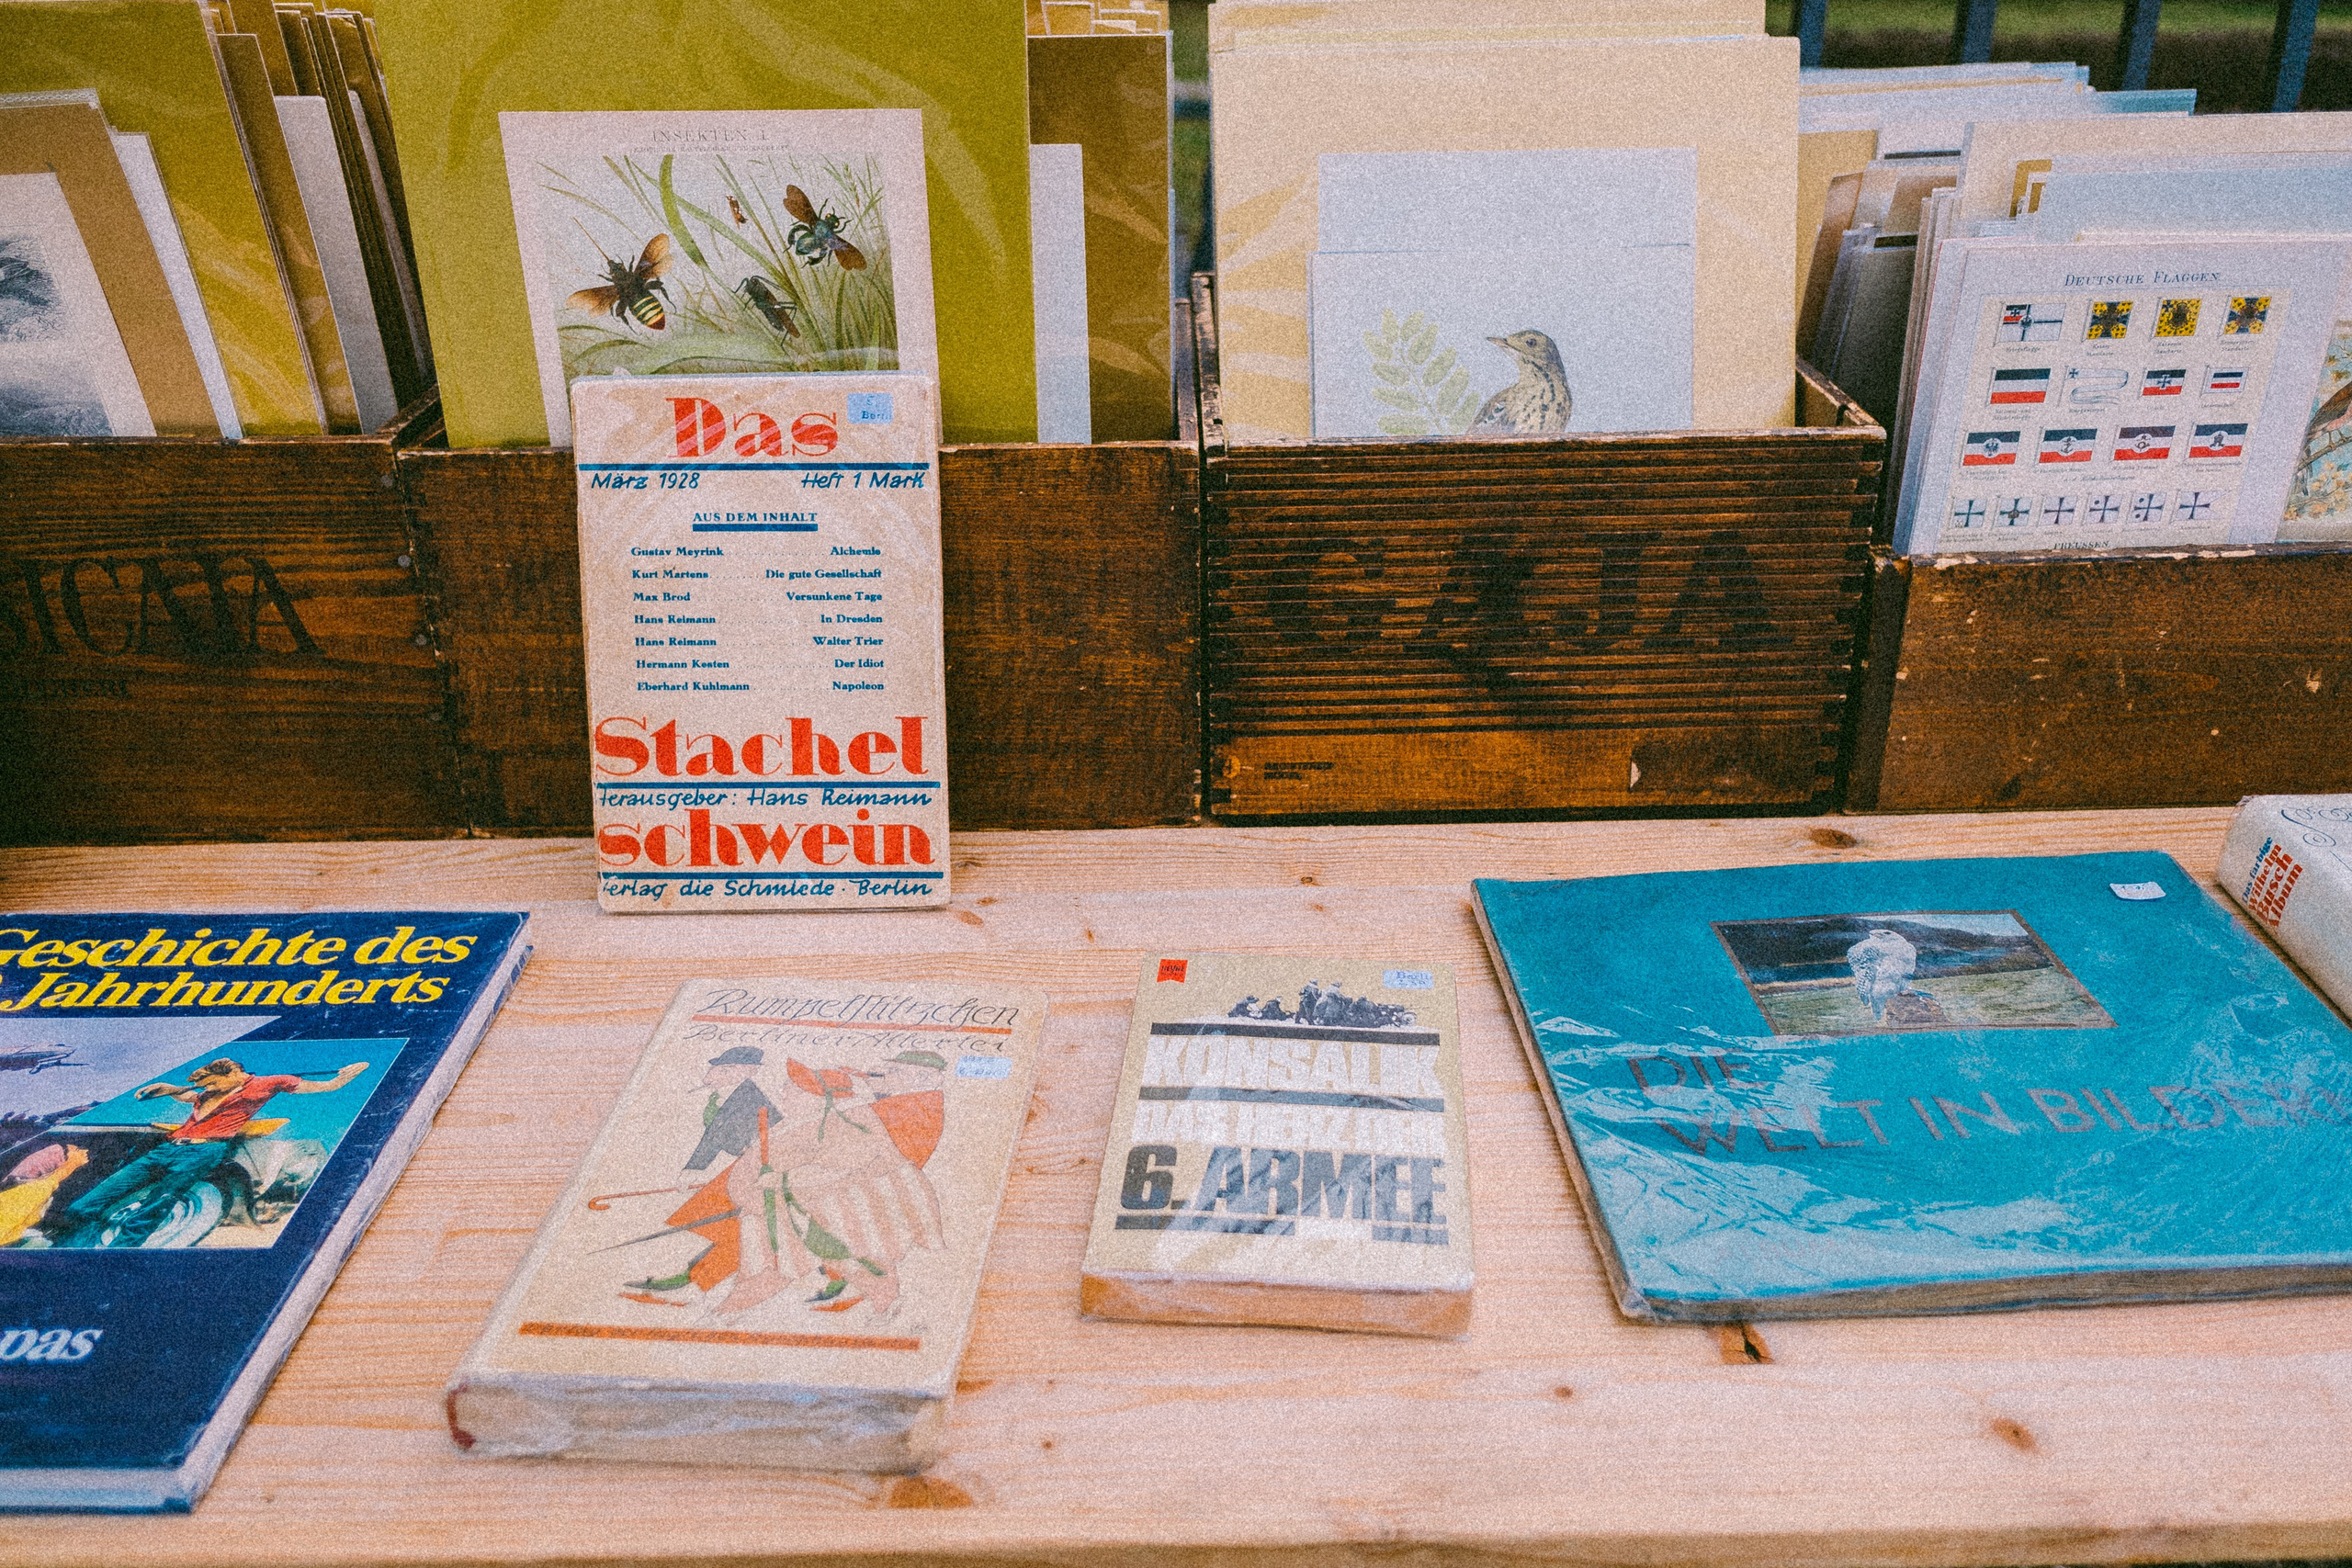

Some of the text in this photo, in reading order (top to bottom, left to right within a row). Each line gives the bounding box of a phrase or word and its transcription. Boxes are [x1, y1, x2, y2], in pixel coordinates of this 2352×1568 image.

[665, 397, 840, 457] Das
[591, 471, 700, 490] März 1928
[801, 471, 925, 489] Heft 1 Mark
[693, 512, 818, 522] AUS DEM INHALT
[630, 546, 881, 558] Gustav Meyrink Alchemie
[632, 569, 882, 581] Kurt Martens Die gute Gesellschaft
[633, 592, 883, 603] Max Brod Versunkene Tage
[634, 614, 883, 624] Hans Reimann In Dresden
[635, 636, 884, 646] Hans Reimann Walter Trier
[636, 659, 885, 669] Hermann Kesten Der Idiot
[637, 681, 885, 693] Eberhard Kuhlmann Napoleon
[594, 716, 929, 776] Stachel
[747, 788, 808, 806] Hans
[820, 787, 933, 807] Reimann
[598, 808, 935, 867] schwein
[680, 879, 712, 897] die
[724, 879, 835, 897] Schmiede
[850, 879, 933, 897] Berlin
[2242, 837, 2273, 904] Das farbige
[2248, 844, 2282, 911] Wilhelm
[2256, 853, 2293, 924] Busch
[2267, 863, 2303, 928] Album
[0, 926, 478, 968] Geschichte des
[0, 970, 451, 1011] Jahrhunderts
[683, 1023, 1009, 1053] Berliner Allerlei
[1141, 1034, 1444, 1098] KONSALIK
[1627, 1048, 1769, 1095] DIE
[1130, 1100, 1446, 1155] DAS HERZ DER
[1654, 1099, 1890, 1156] WELT
[1908, 1090, 2022, 1141] IN
[1120, 1145, 1449, 1225] 6. ARMEE
